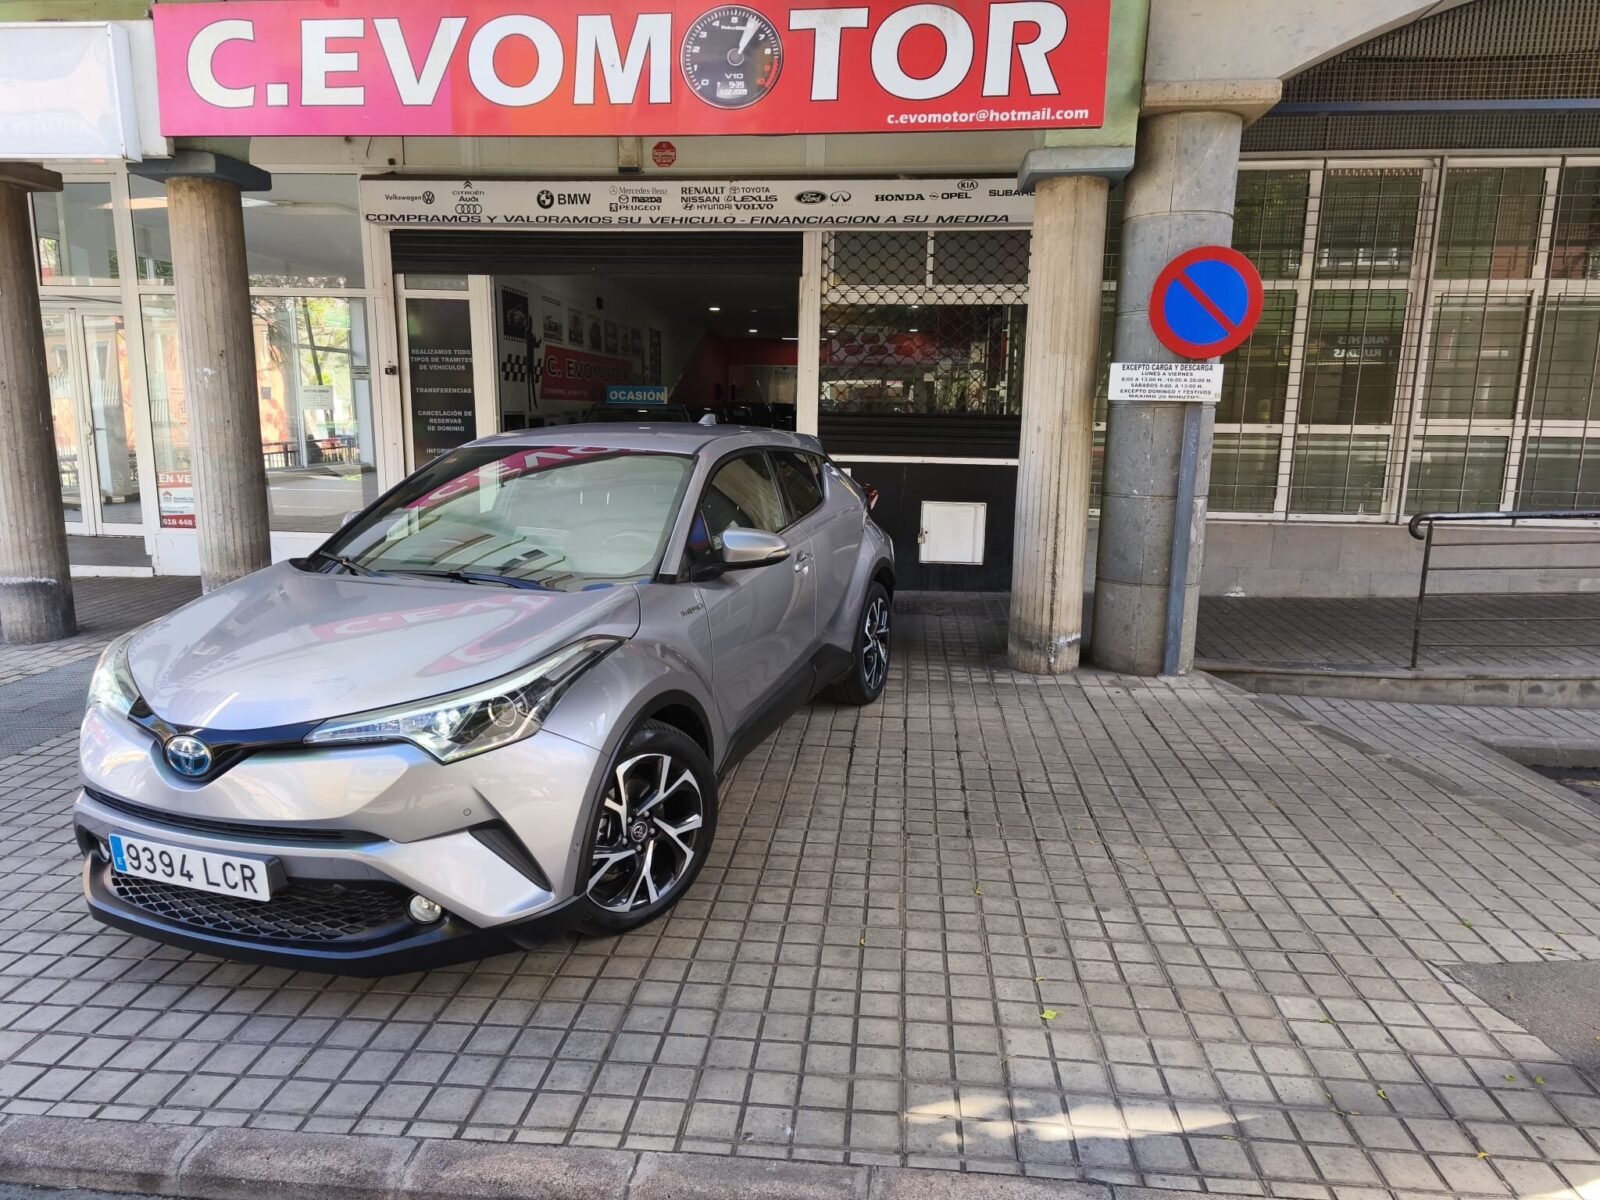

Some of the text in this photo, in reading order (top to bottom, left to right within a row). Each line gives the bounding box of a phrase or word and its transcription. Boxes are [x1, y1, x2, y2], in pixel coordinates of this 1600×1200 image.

[886, 107, 1089, 125] c.evomotor@hotmail.com
[960, 180, 975, 189] KIA
[618, 186, 668, 195] Mercedes-Benz
[680, 186, 726, 195] RENAULT
[741, 186, 771, 194] TOYOTA
[384, 194, 422, 202] Volkswagen
[557, 193, 591, 205] BMW
[680, 195, 720, 204] NISSAN
[733, 194, 778, 203] LEXUS
[874, 193, 926, 202] HONDA
[941, 192, 972, 200] OPEL
[619, 204, 662, 212] PEUGEOT
[735, 203, 774, 211] VOLVO
[365, 213, 482, 223] COMPRAMOS
[486, 215, 498, 223] Y
[503, 215, 613, 224] VALORAMOS
[617, 216, 642, 224] SU
[648, 216, 736, 225] VEHICULO
[749, 215, 881, 225] FINANCIACION
[884, 215, 898, 223] A
[902, 215, 929, 223] SU
[935, 214, 1010, 224] MEDIDA
[1122, 363, 1150, 371] EXCEPTO
[1180, 364, 1214, 372] DESCARGA
[609, 388, 665, 402] OCASIÓN
[158, 474, 174, 483] EN
[125, 843, 194, 882] 9394
[202, 857, 259, 894] LCR
